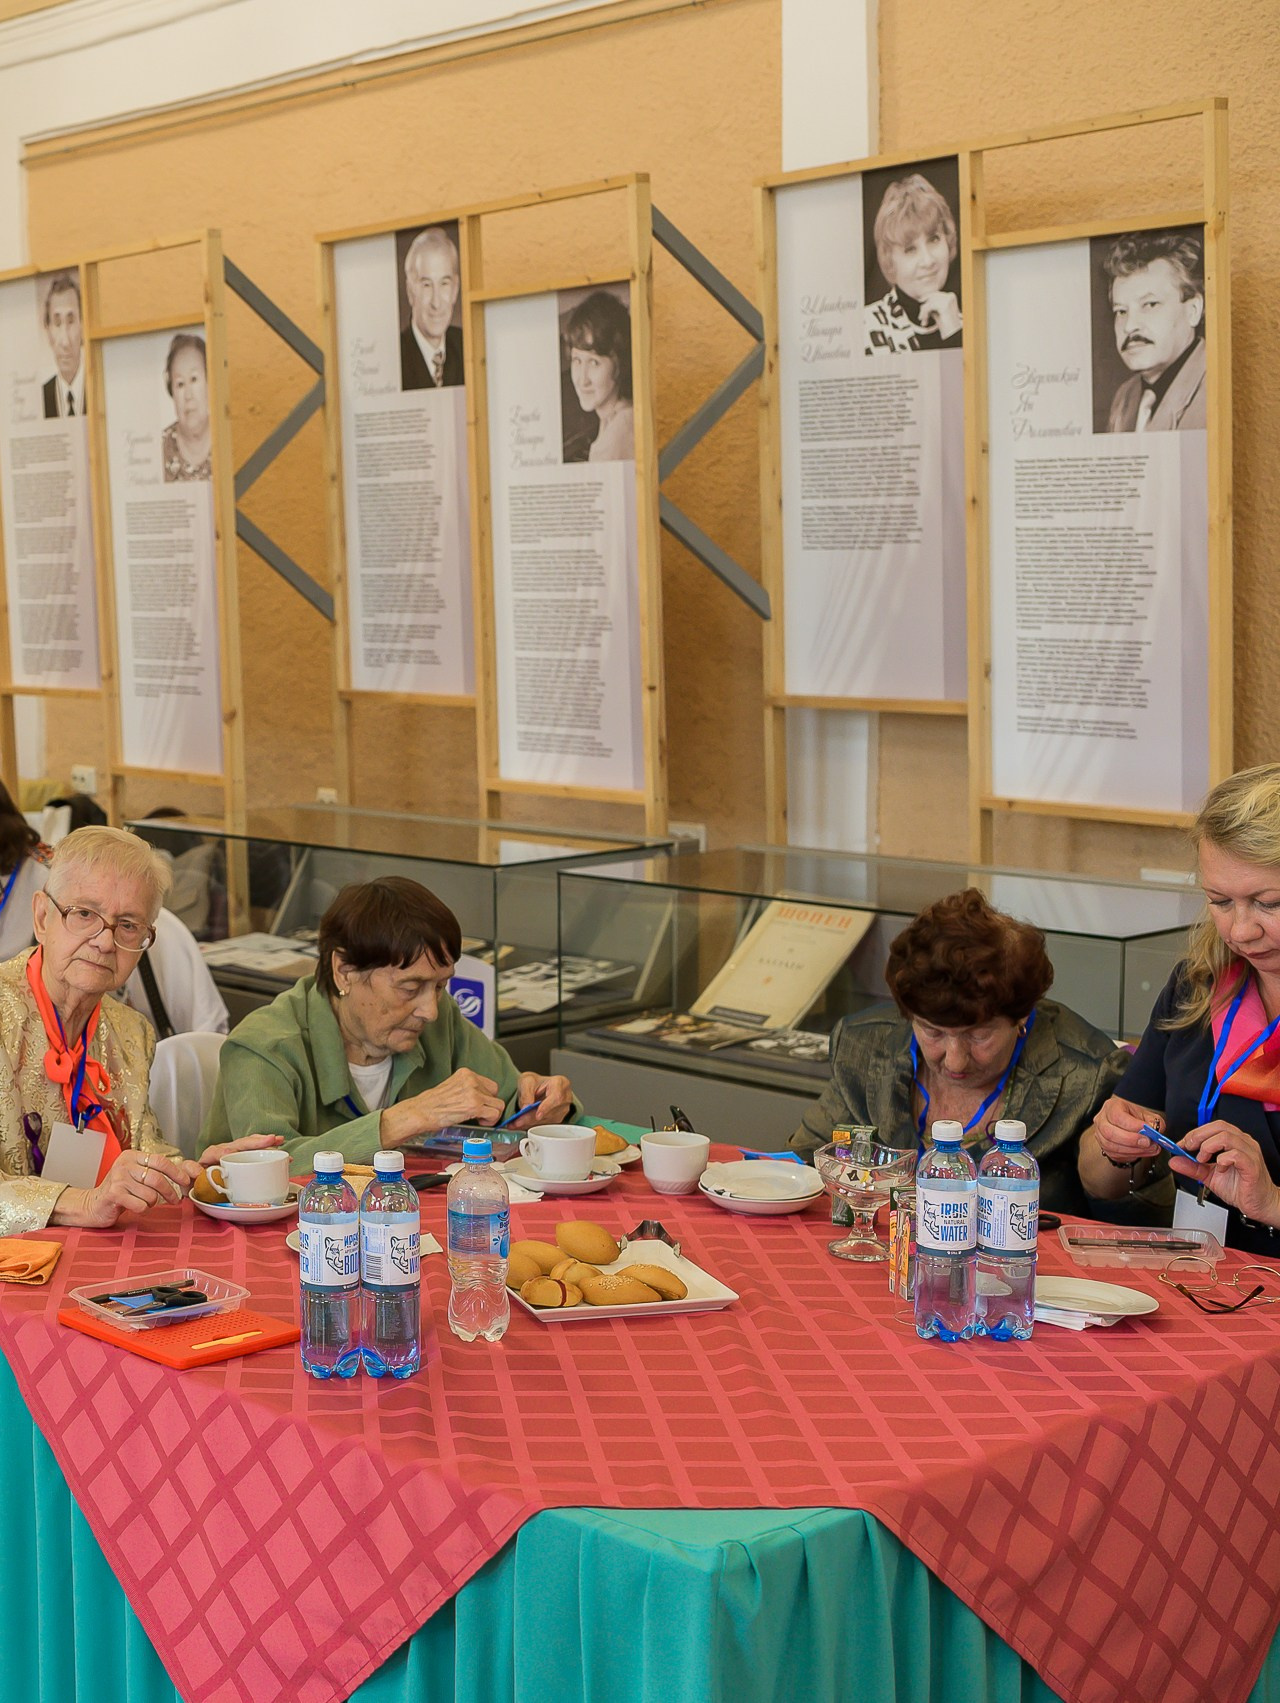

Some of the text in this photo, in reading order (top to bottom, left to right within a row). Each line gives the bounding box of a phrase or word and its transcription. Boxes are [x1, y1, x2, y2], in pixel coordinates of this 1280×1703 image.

[776, 905, 853, 930] ШОПЕН
[940, 1202, 968, 1218] IRBIS
[940, 1225, 968, 1242] WATER
[344, 1252, 359, 1276] ВОД
